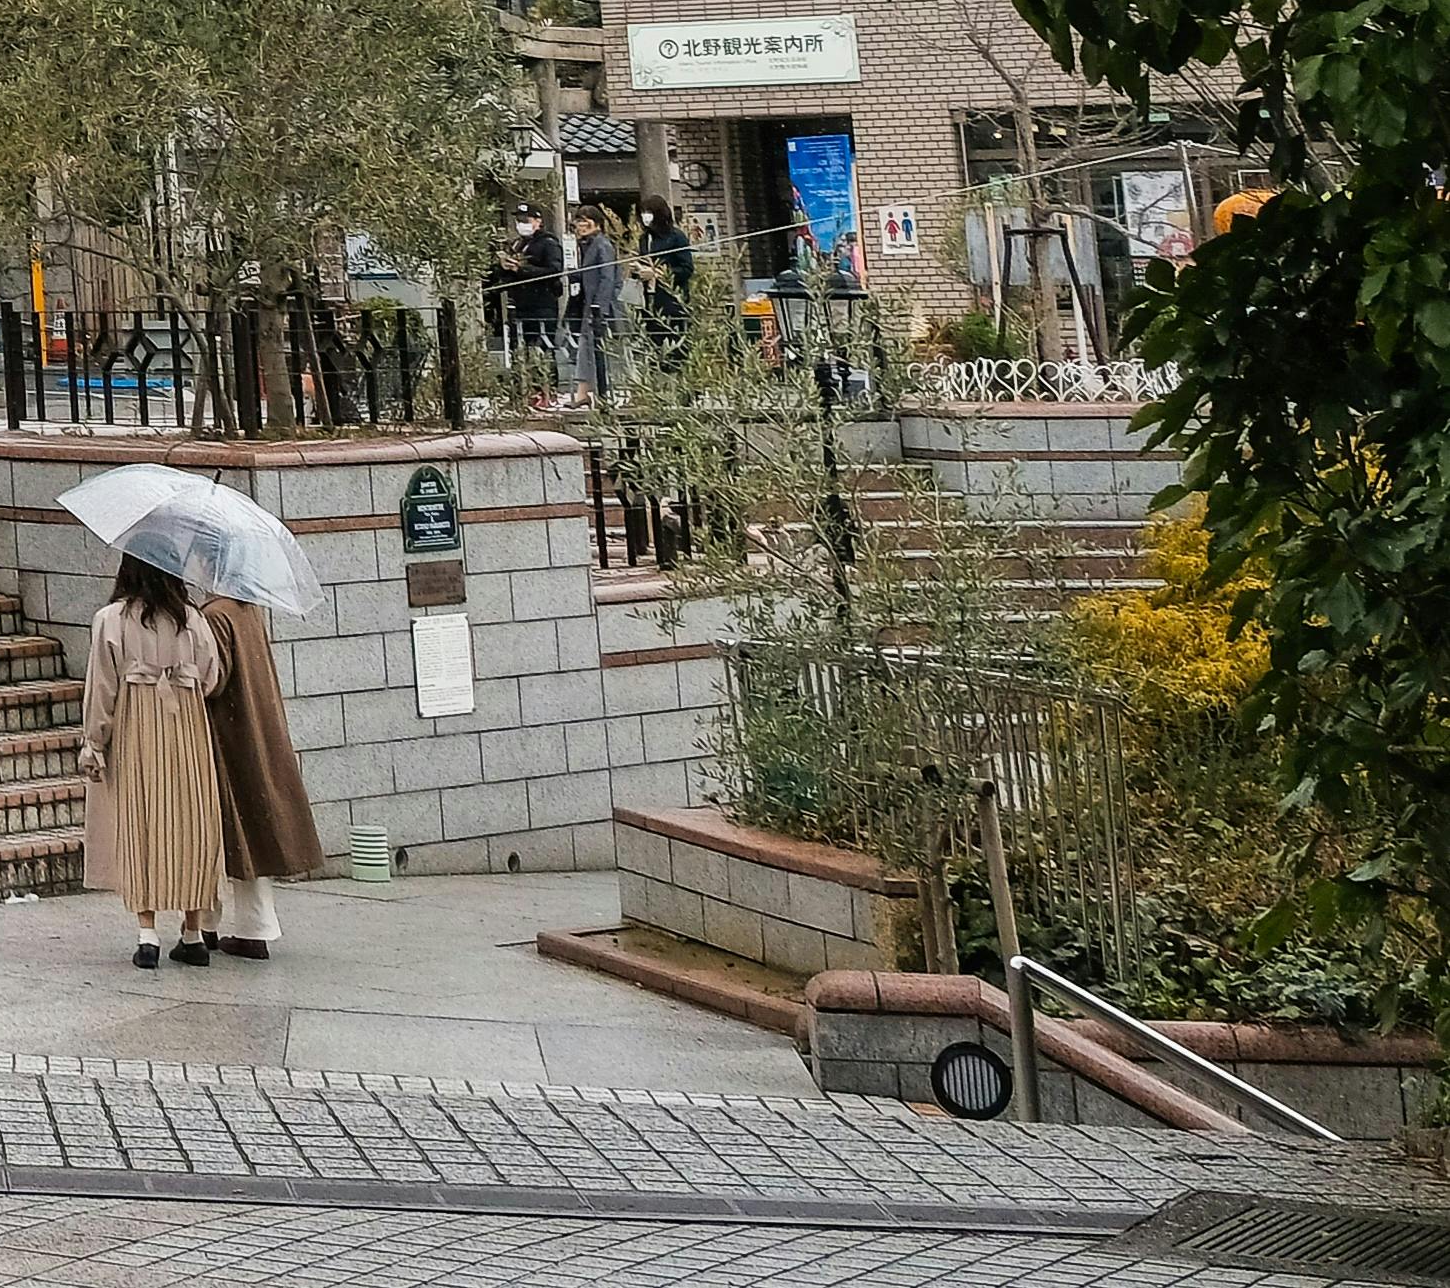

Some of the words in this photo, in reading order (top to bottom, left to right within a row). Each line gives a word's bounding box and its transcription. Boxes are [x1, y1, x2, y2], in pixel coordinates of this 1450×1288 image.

[682, 34, 824, 57] 北野観光案内所
